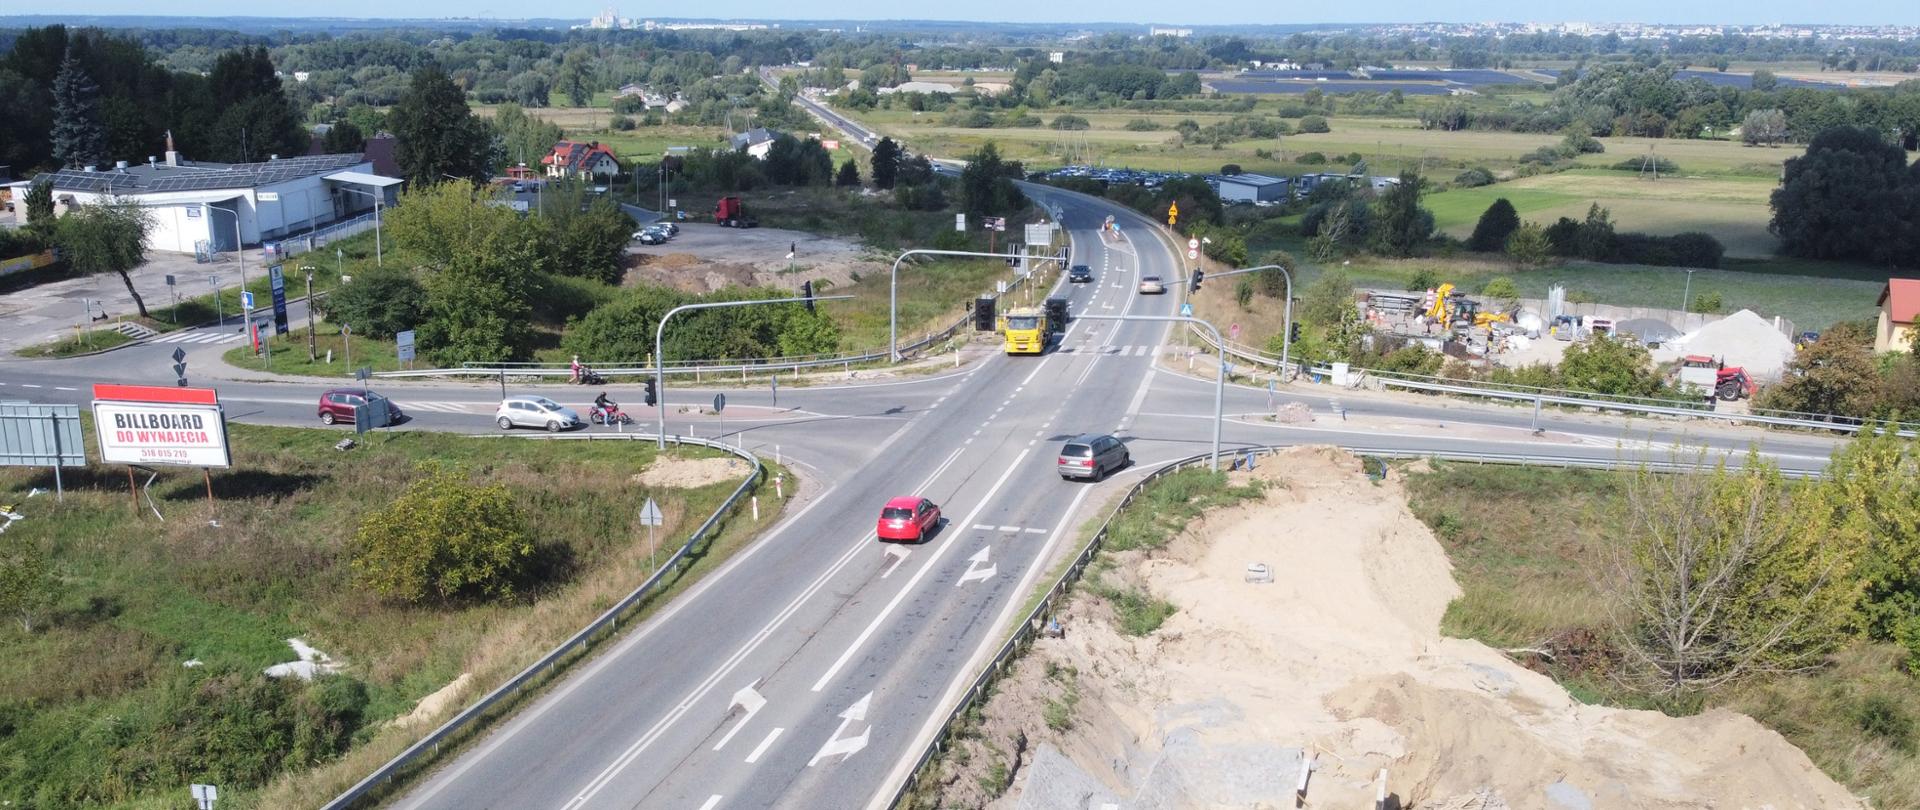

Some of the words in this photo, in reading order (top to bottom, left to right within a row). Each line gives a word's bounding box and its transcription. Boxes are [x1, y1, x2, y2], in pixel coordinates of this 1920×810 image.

[115, 413, 203, 429] BILLBOARD
[117, 430, 134, 443] DO
[137, 431, 209, 445] WYNAJĘCIA
